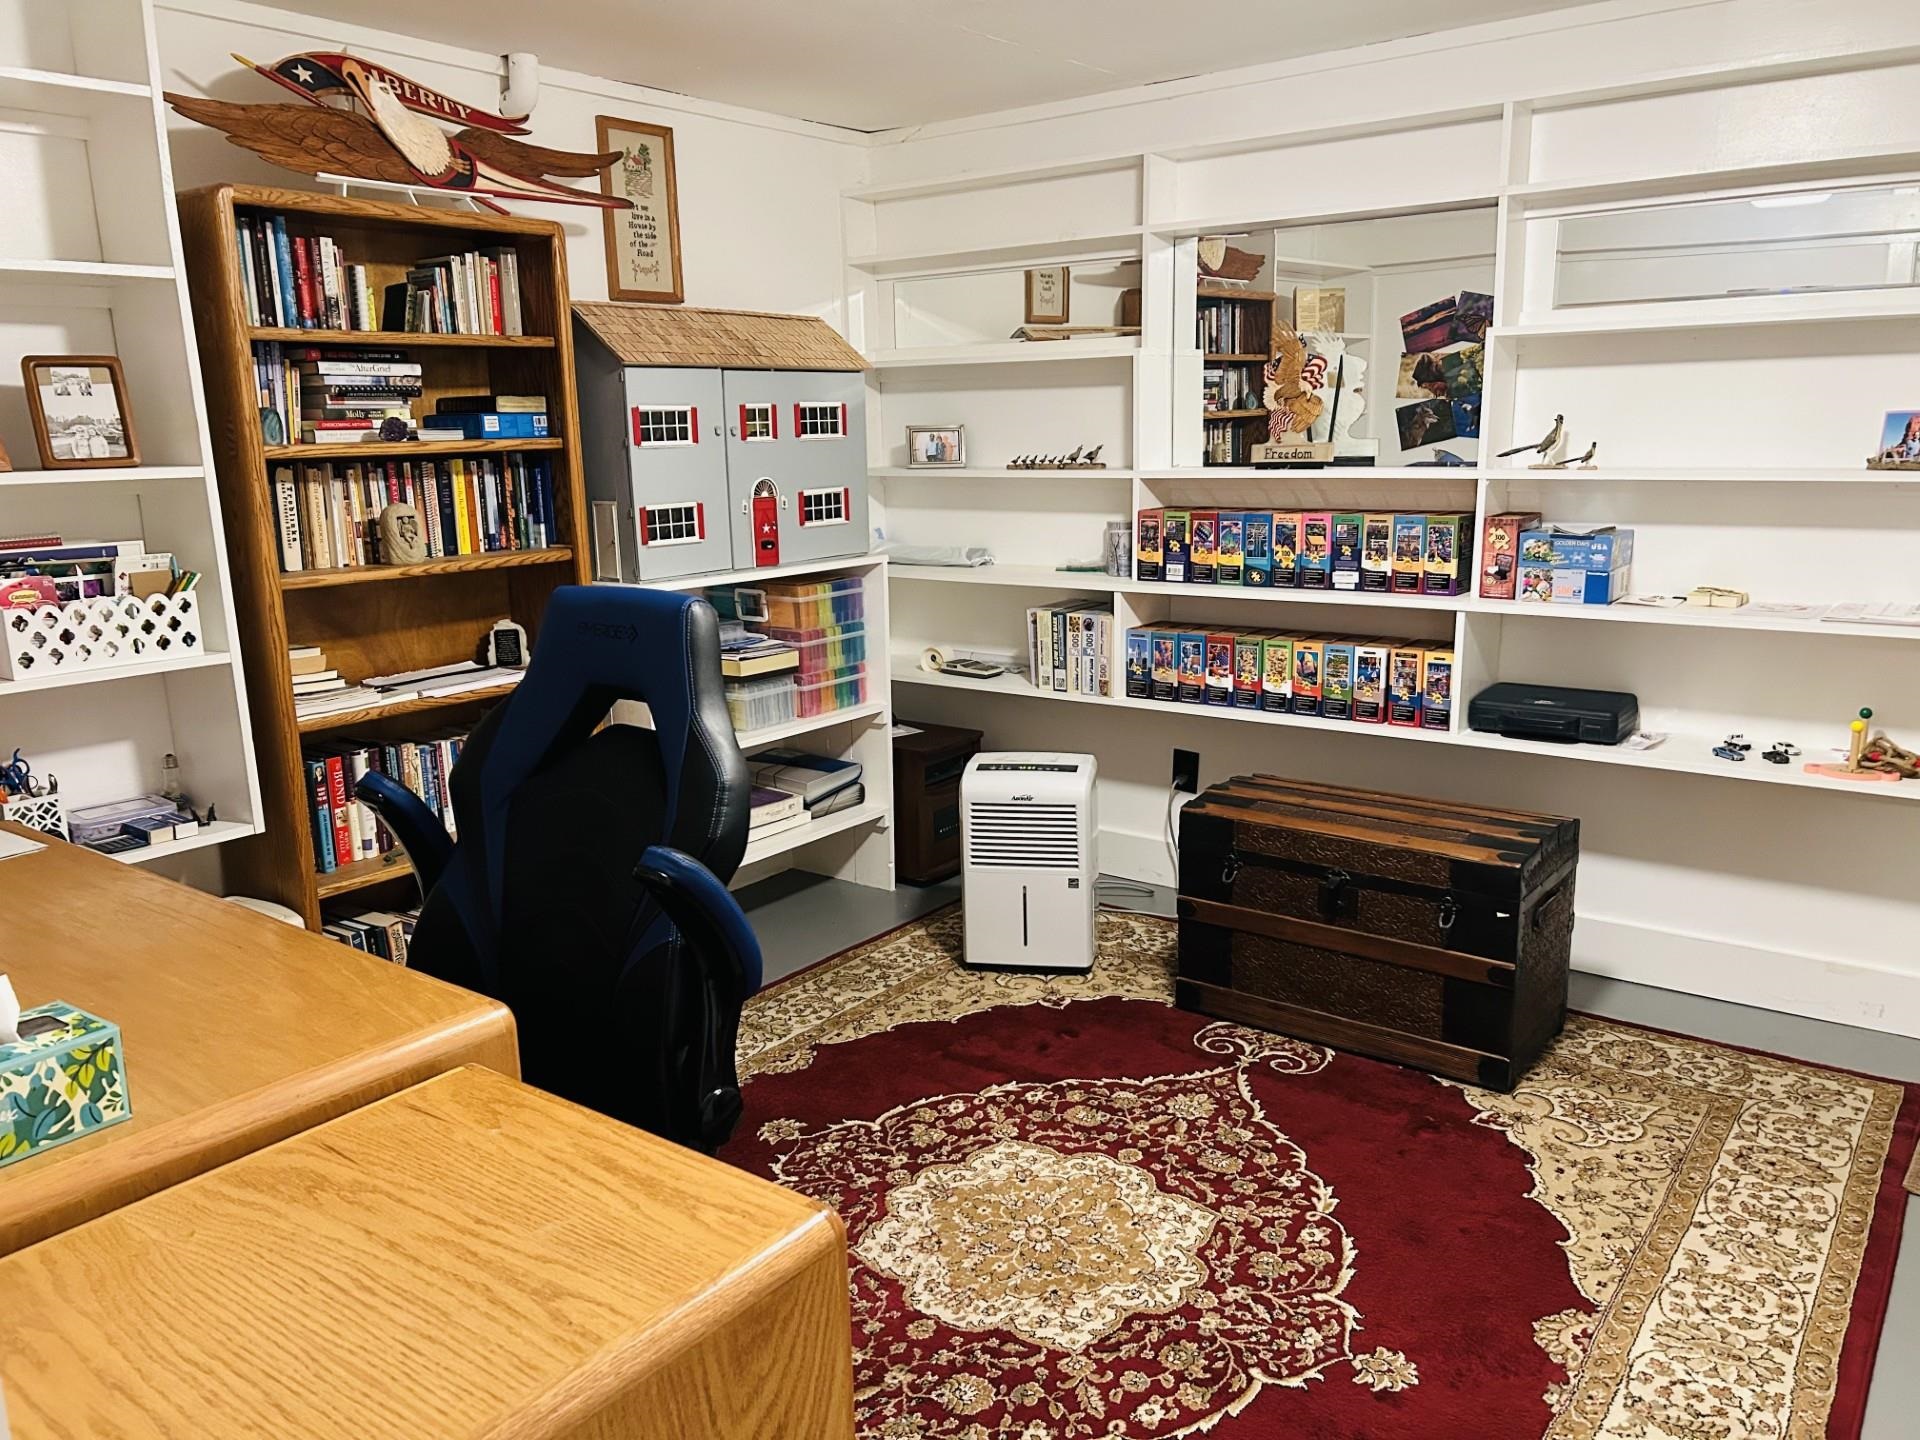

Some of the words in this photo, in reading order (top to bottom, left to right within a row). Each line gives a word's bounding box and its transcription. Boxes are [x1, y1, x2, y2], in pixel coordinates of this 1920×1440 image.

[369, 68, 472, 119] IBERTY
[631, 212, 644, 221] live
[628, 220, 648, 230] House
[649, 222, 656, 232] by
[633, 231, 644, 239] the
[644, 232, 657, 240] side
[629, 240, 637, 248] of
[638, 240, 648, 248] the
[637, 248, 654, 258] Road
[345, 409, 366, 419] Molly
[1263, 447, 1313, 460] Freedom
[286, 486, 297, 543] Treblinka
[1071, 633, 1080, 648] 500
[1085, 633, 1094, 648] 500
[1099, 664, 1107, 679] 500
[334, 771, 346, 805] BOND
